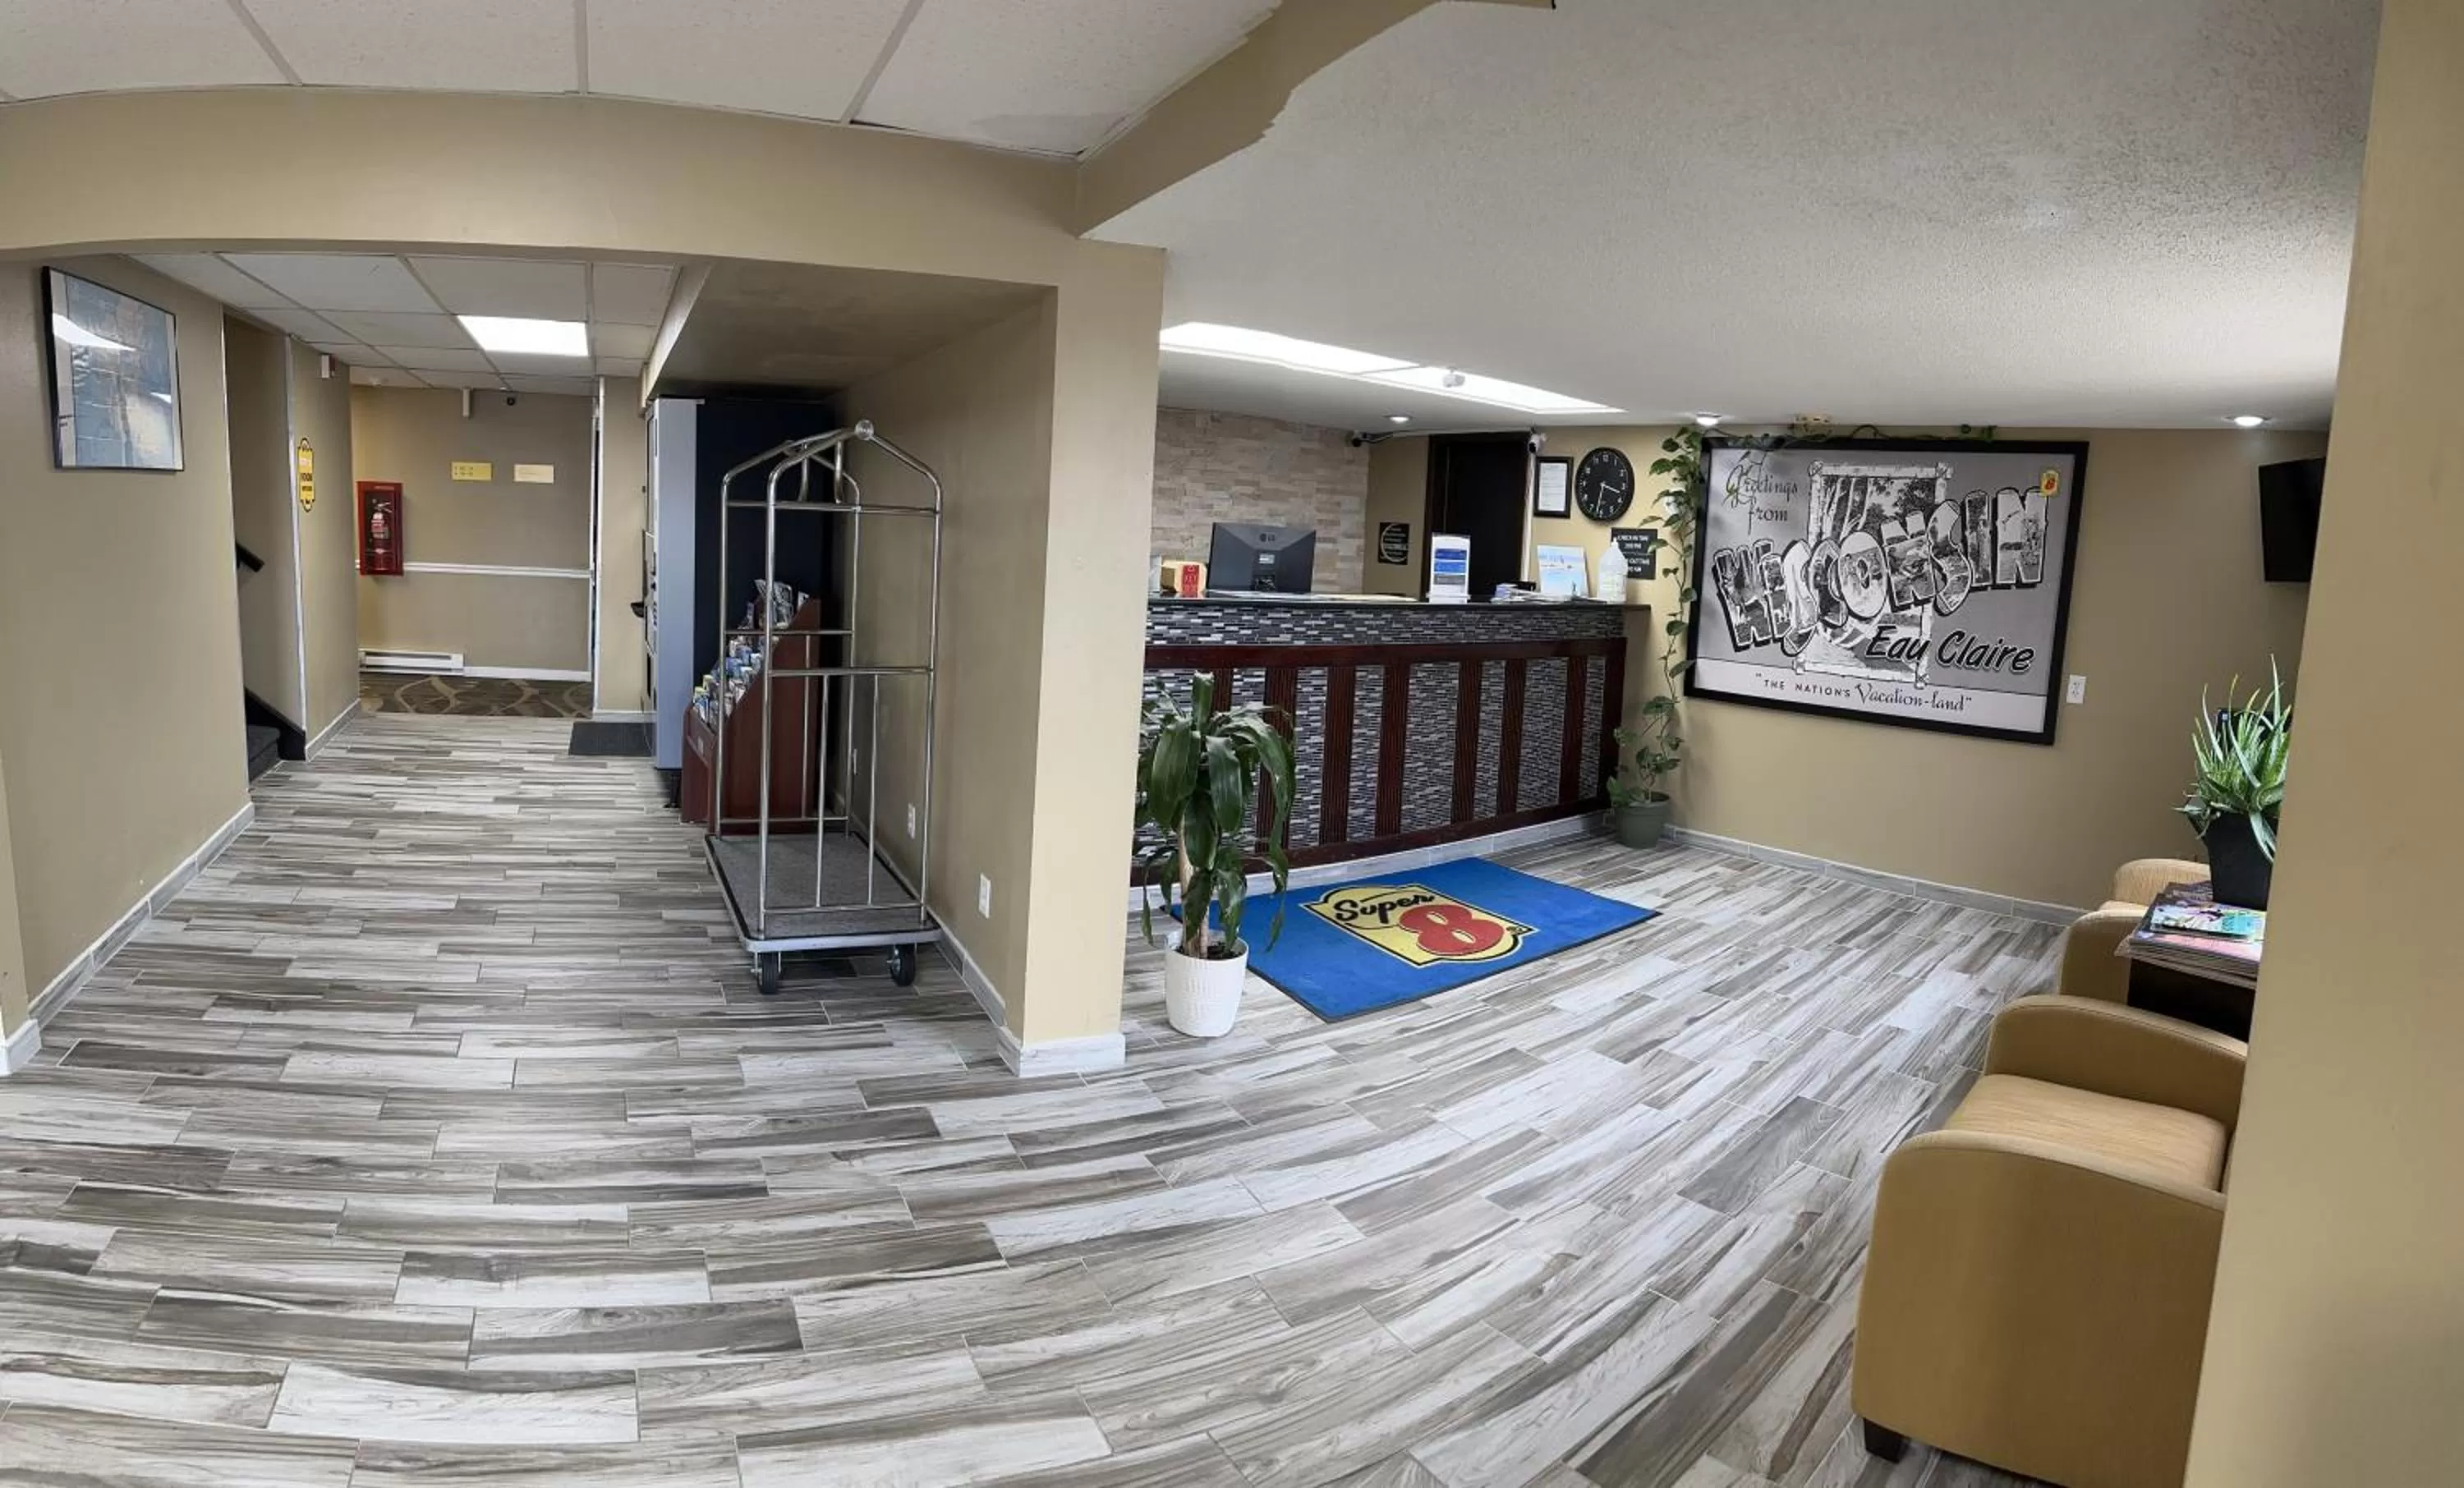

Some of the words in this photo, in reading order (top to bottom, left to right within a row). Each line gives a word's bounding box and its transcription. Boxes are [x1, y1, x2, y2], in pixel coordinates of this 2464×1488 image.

[1747, 496, 1788, 535] from
[1259, 532, 1276, 543] LG
[1866, 624, 1931, 660] Eau
[1937, 629, 2036, 674] Claire
[1332, 893, 1436, 925] Super
[1399, 903, 1505, 956] 8
